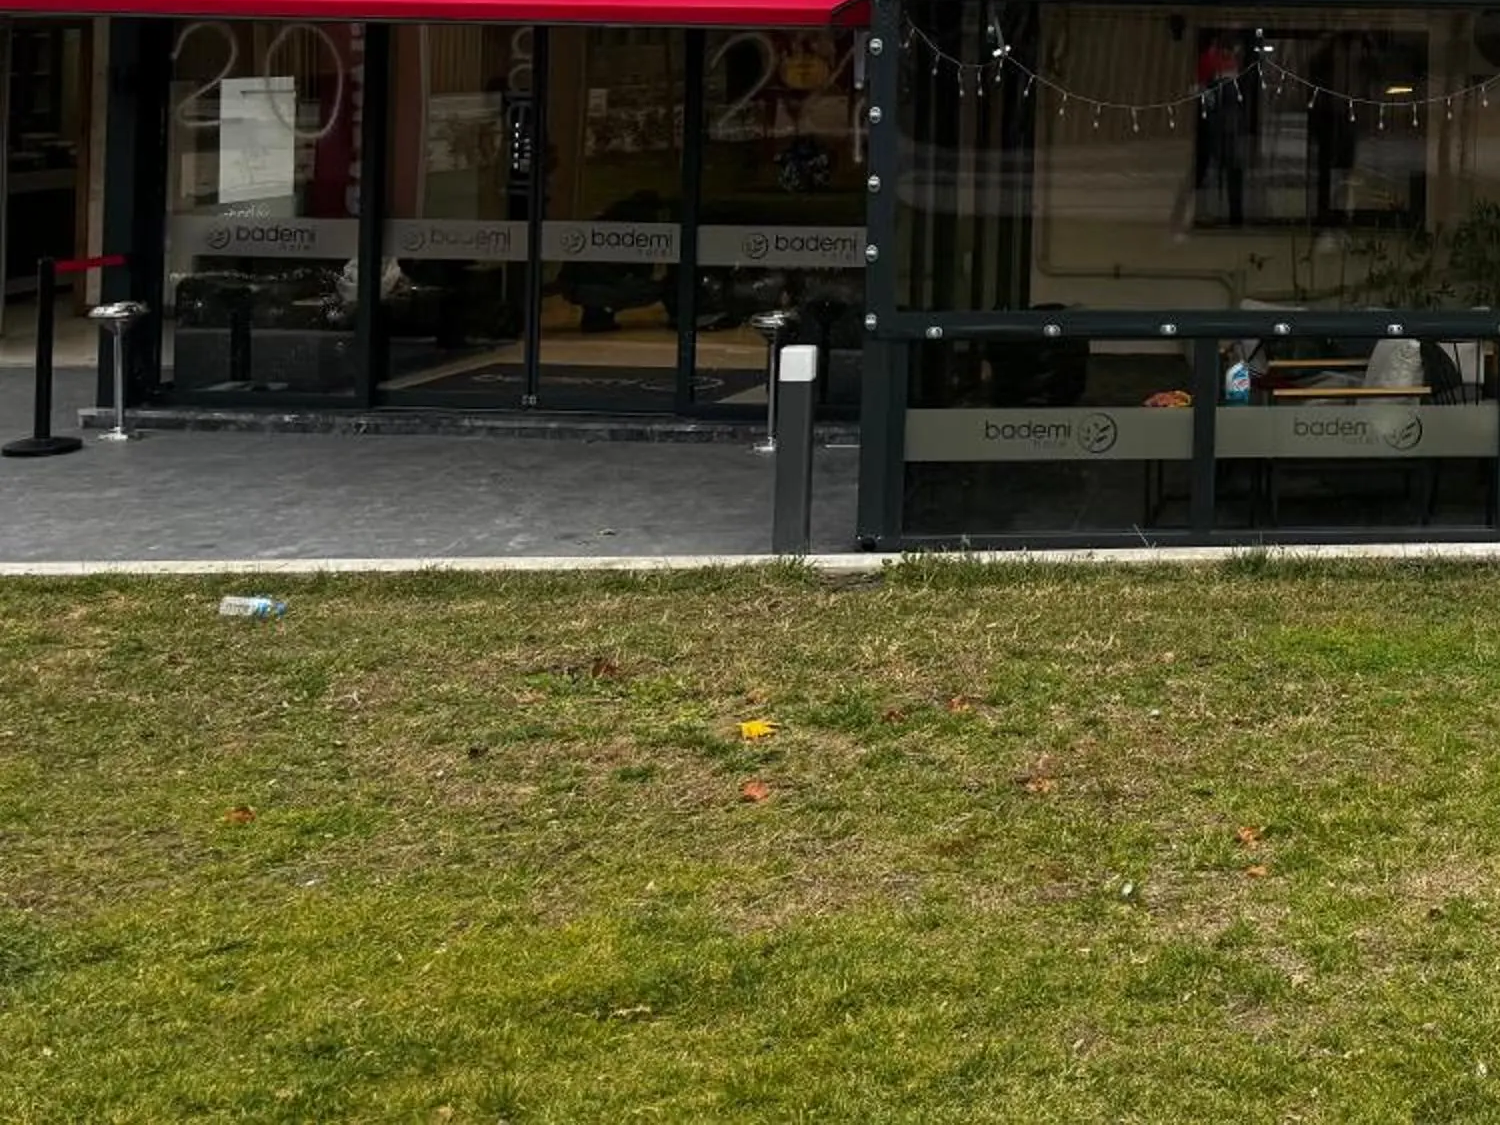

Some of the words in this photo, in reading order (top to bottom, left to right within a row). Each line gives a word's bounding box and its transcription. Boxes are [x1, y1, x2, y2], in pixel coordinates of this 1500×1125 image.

[235, 225, 316, 243] bademi
[592, 228, 672, 249] bademi
[775, 234, 857, 253] bademi
[985, 419, 1071, 439] bademi
[1294, 416, 1372, 436] badem
